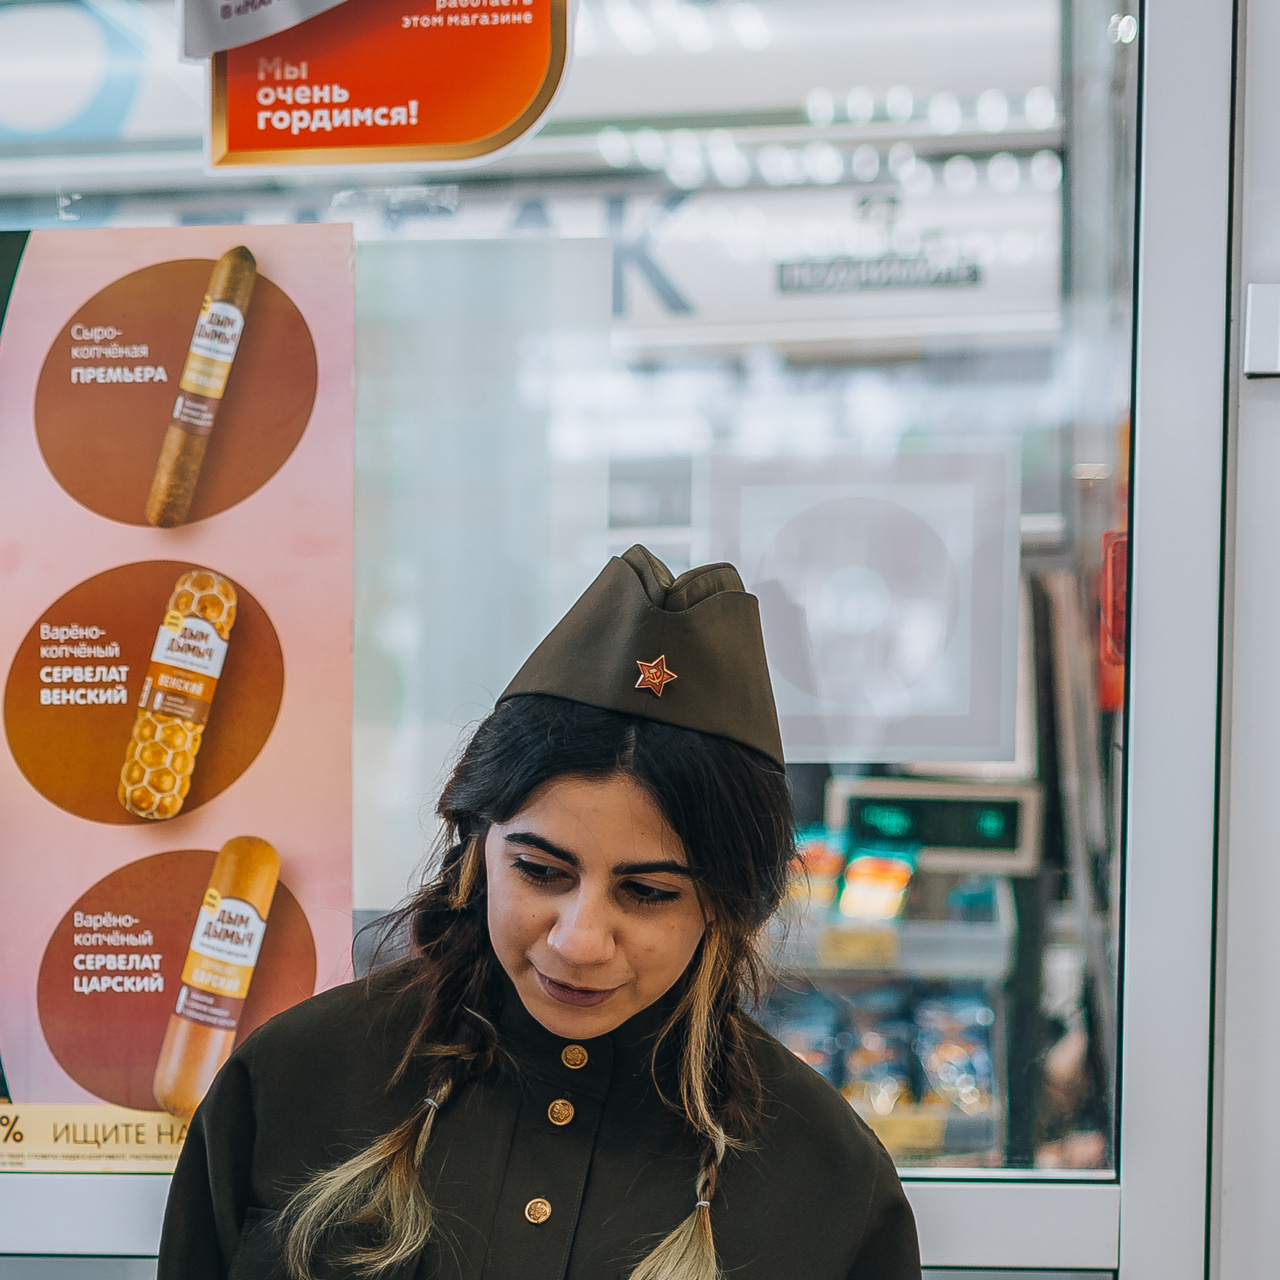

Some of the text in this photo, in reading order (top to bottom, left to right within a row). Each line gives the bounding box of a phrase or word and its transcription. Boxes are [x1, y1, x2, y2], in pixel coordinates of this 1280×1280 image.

[401, 11, 533, 28] этом магазине
[257, 57, 308, 81] Мы
[256, 84, 350, 105] очень
[257, 100, 419, 135] гордимся!
[71, 323, 123, 343] Сыро-
[71, 342, 149, 359] копчёная
[71, 366, 168, 384] ПРЕМЬЕРА
[40, 623, 106, 643] Варёно-
[40, 641, 120, 659] копчёный
[40, 666, 129, 683] СЕРВЕЛАТ
[40, 684, 128, 706] ВЕНСКИЙ
[73, 911, 140, 931] Варёно-
[73, 930, 153, 947] копчёный
[73, 954, 162, 971] СЕРВЕЛАТ
[73, 973, 165, 995] ЦАРСКИЙ
[53, 1123, 146, 1149] ИЩИТЕ
